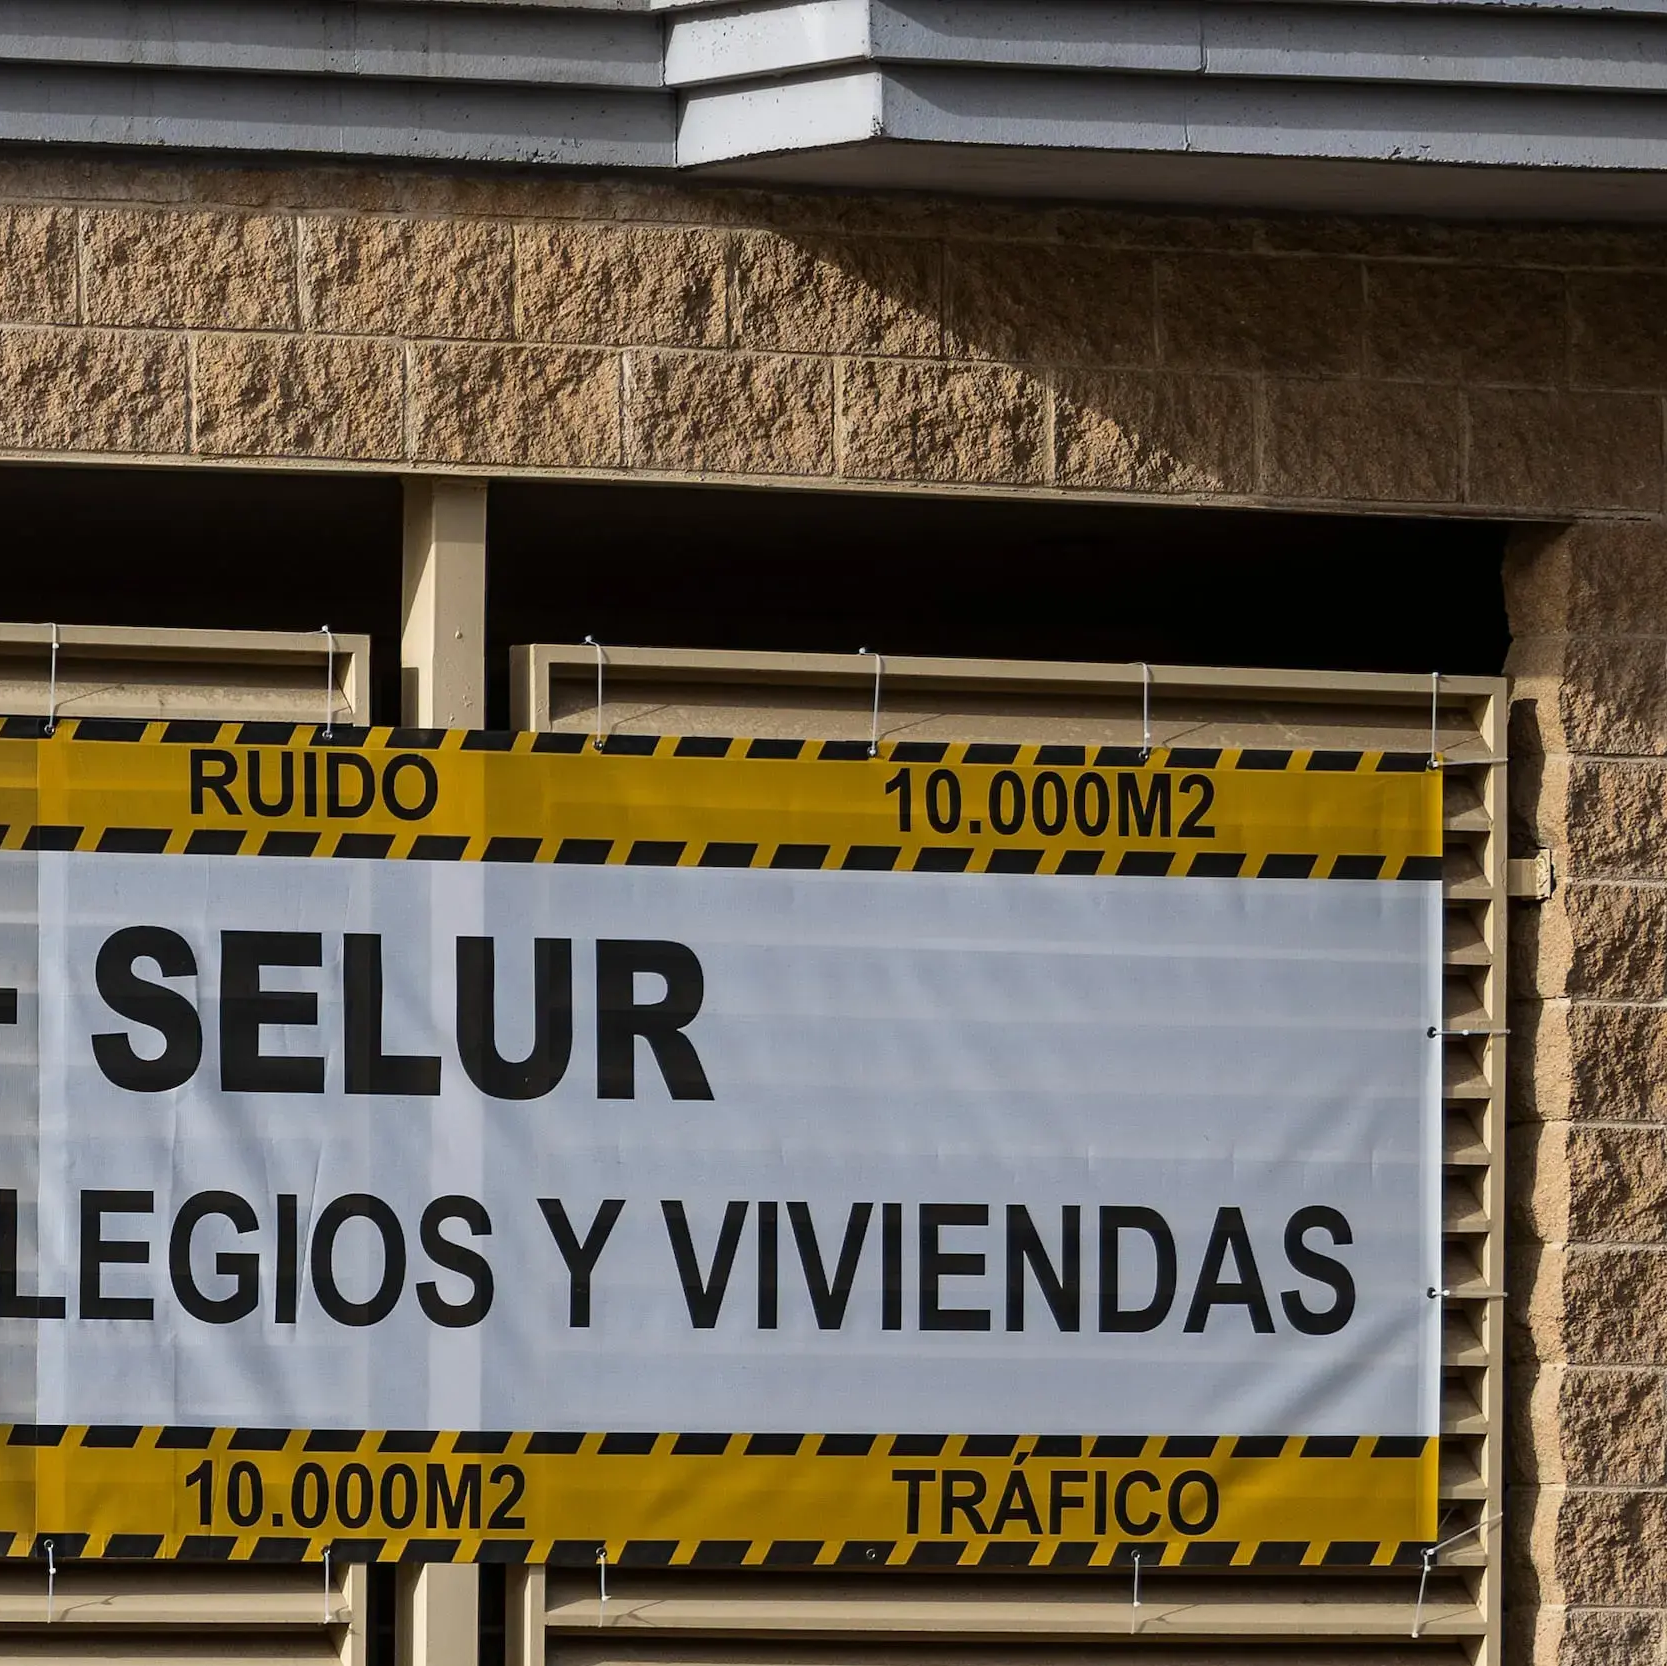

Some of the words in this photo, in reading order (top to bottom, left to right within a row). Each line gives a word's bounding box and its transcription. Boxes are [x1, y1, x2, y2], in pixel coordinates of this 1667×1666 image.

[188, 748, 439, 821] RUIDO
[884, 767, 1216, 839] 10.000M2
[90, 924, 716, 1102] SELUR
[536, 1197, 627, 1329] Y
[659, 1199, 1357, 1336] VIVIENDAS
[184, 1459, 527, 1531] 10.000M2
[890, 1451, 1220, 1538] TRÁFICO
